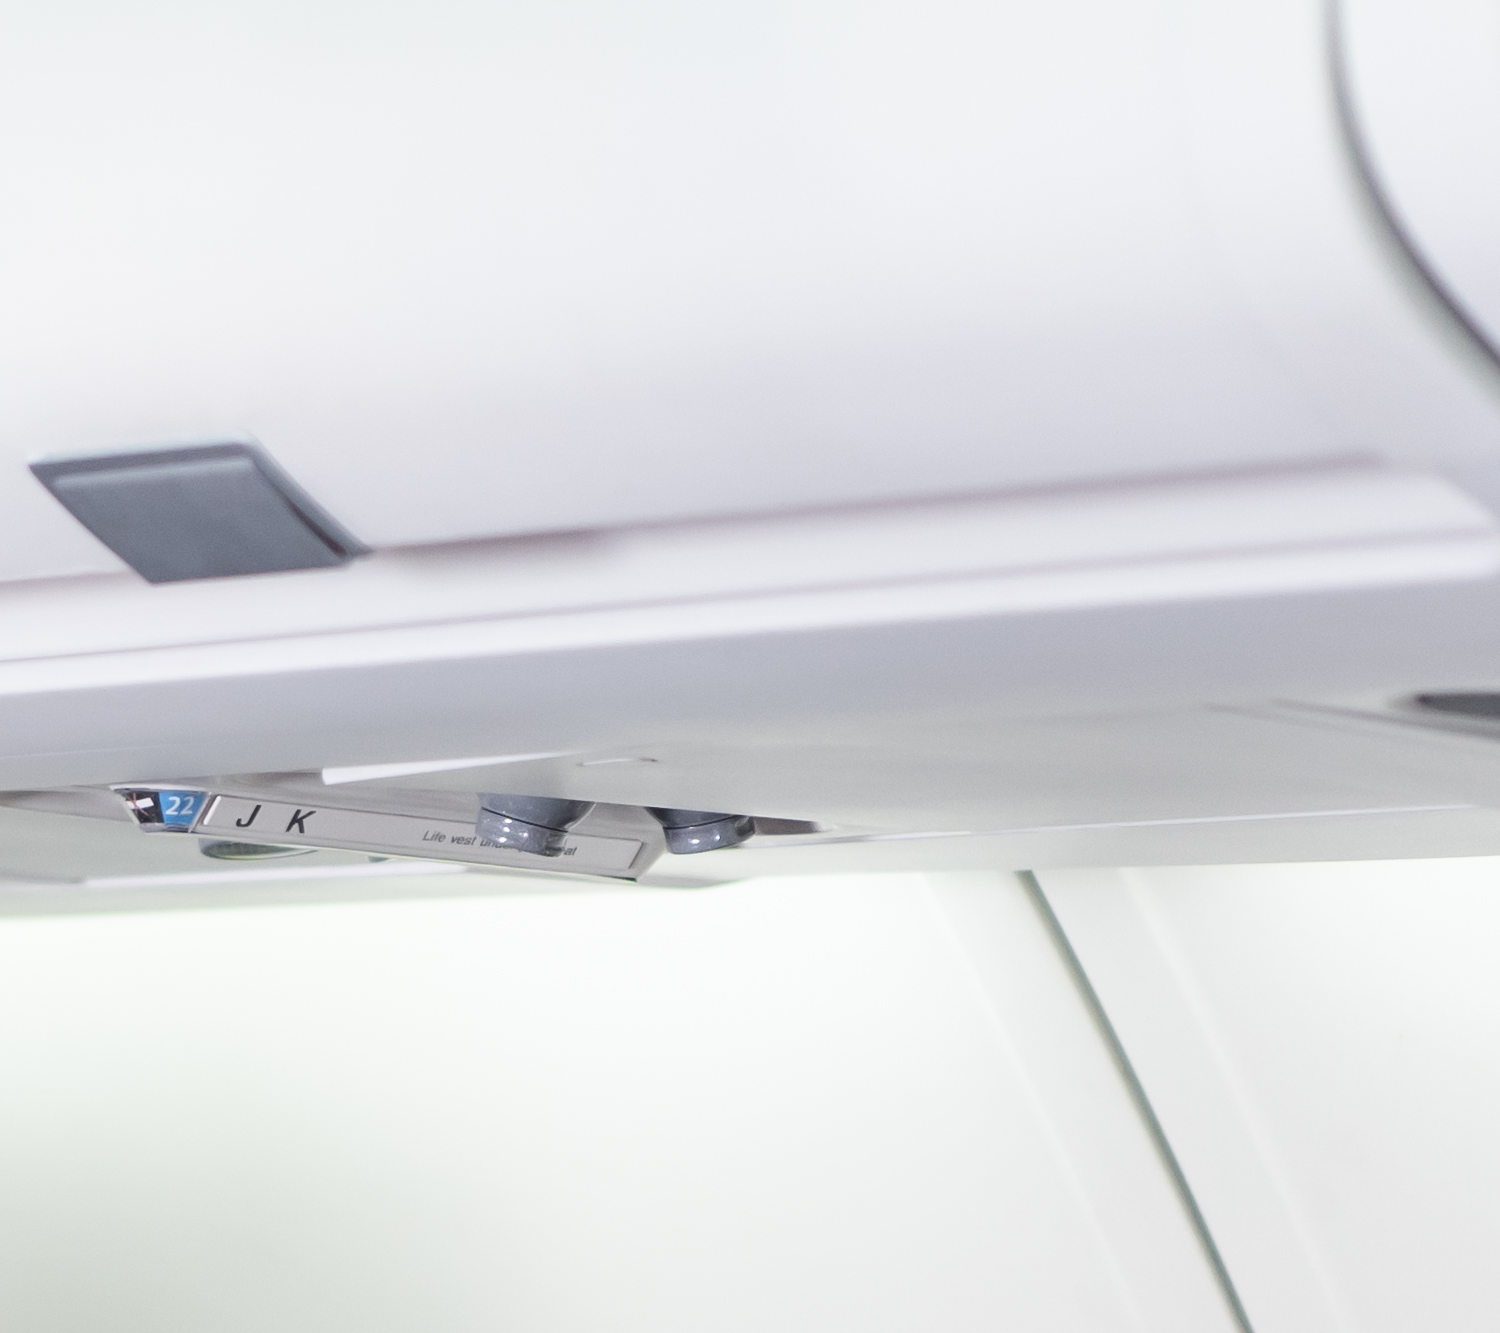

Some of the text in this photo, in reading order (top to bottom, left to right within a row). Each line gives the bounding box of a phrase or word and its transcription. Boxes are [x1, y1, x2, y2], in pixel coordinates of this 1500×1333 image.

[165, 796, 195, 815] 22
[236, 804, 316, 834] J K
[422, 830, 446, 843] Life
[450, 835, 477, 846] vest
